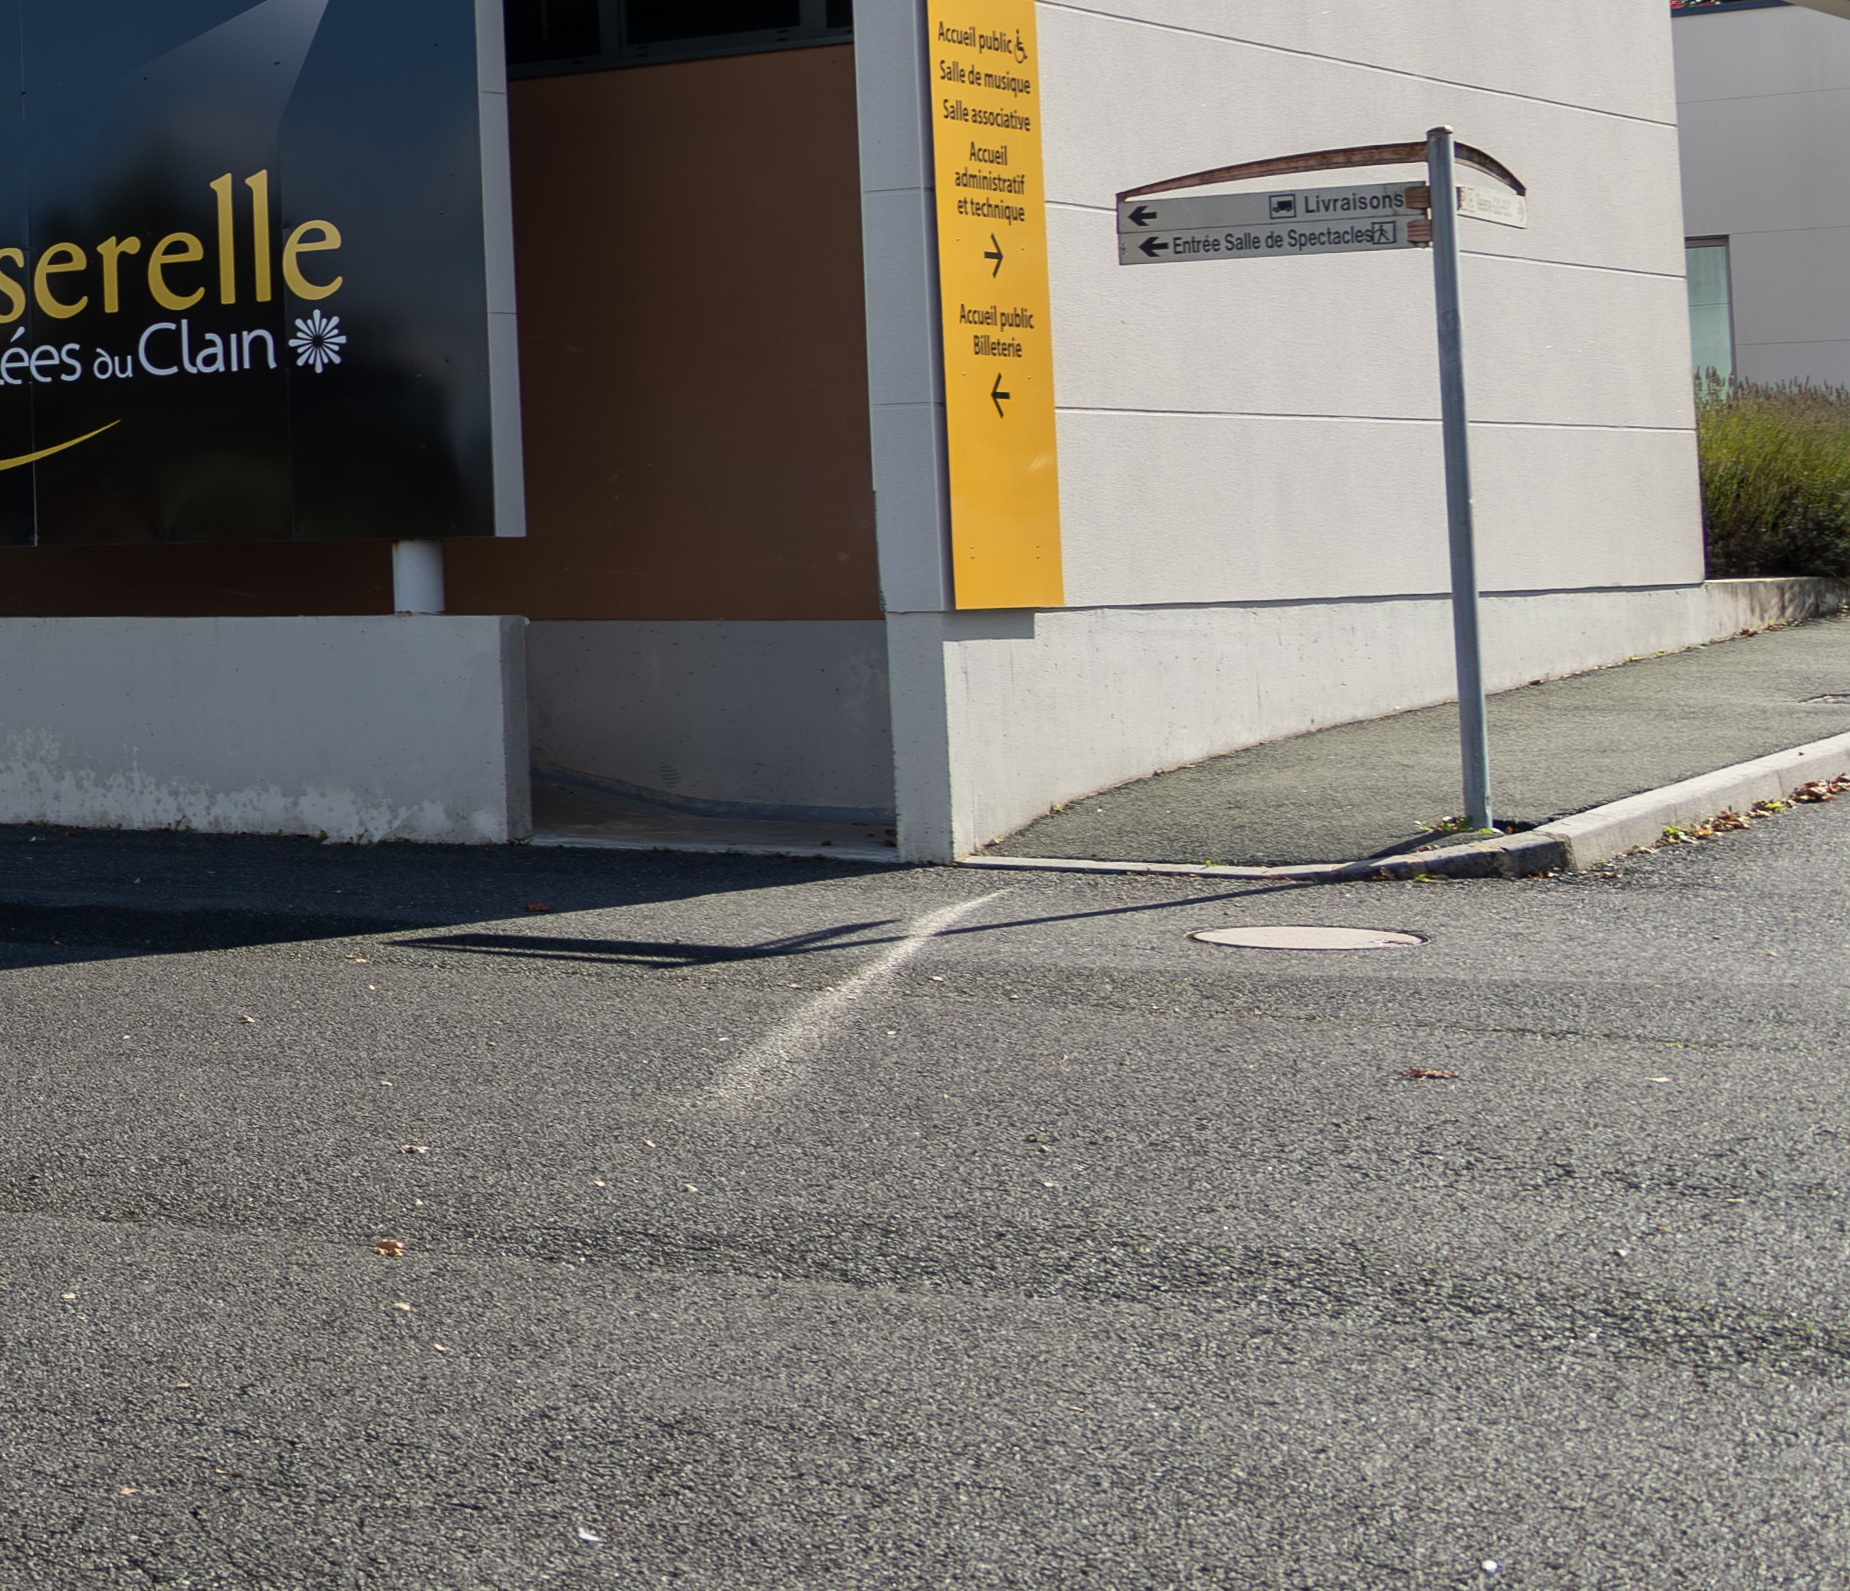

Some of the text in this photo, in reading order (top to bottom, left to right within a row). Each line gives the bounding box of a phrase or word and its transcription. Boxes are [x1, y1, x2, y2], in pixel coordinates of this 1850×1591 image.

[938, 21, 1013, 56] Accueil public
[940, 59, 1031, 97] Salle de musique
[943, 98, 1031, 132] Salle associative
[969, 141, 1008, 167] Accueil
[955, 169, 1026, 196] administratif
[957, 198, 1025, 226] et technique
[1304, 190, 1405, 214] Livraisons
[1173, 224, 1374, 255] Entrée Salle de Spectacles
[959, 303, 1034, 334] Accueil public
[93, 345, 134, 380] au
[138, 319, 278, 377] Clain
[974, 335, 1023, 359] Billeterie
